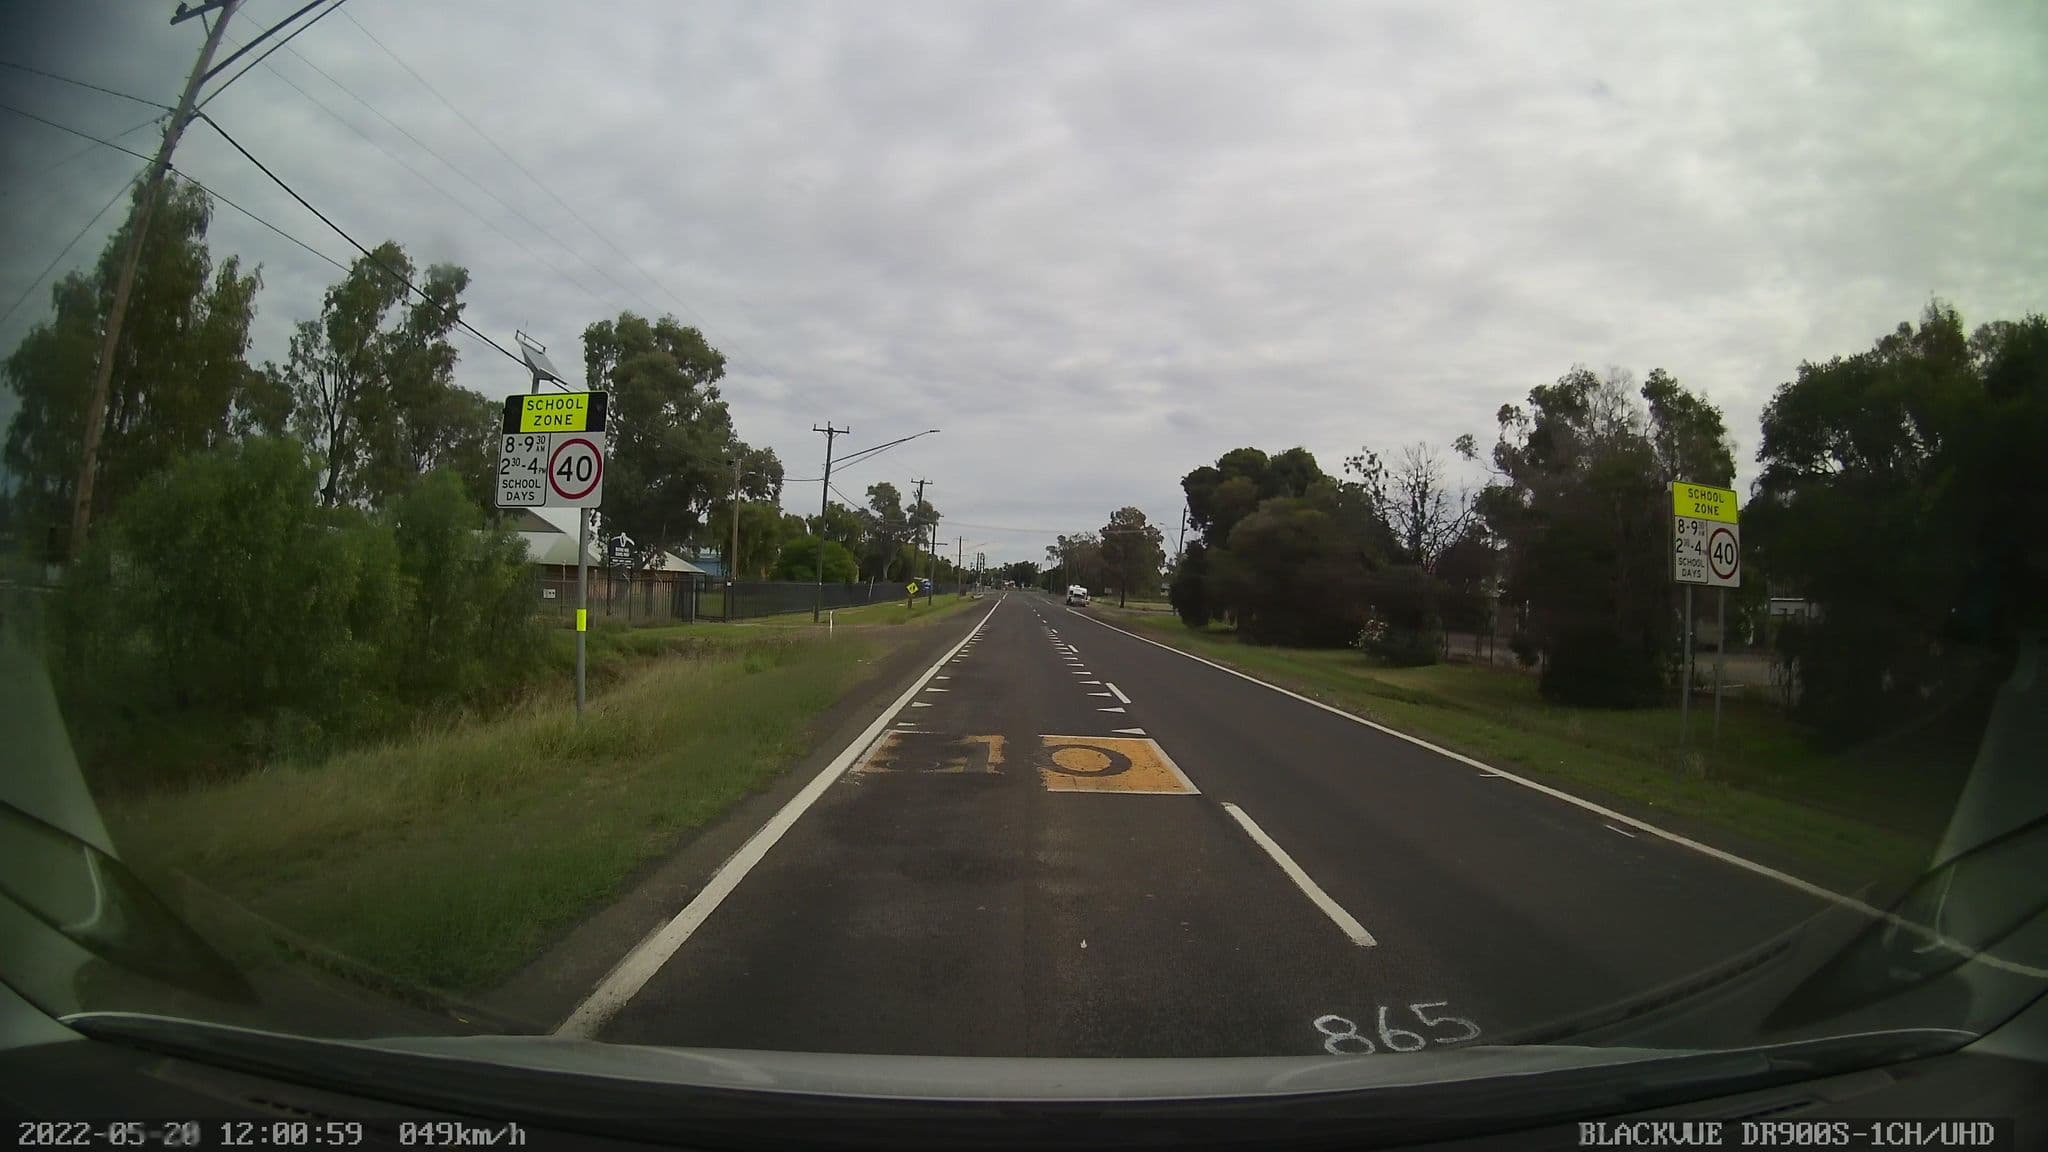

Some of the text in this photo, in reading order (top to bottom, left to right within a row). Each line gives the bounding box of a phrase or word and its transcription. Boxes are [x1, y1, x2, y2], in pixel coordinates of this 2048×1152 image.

[526, 398, 584, 411] SCHOOL
[533, 414, 574, 426] ZONE
[556, 455, 593, 482] 40
[502, 478, 541, 489] SCHOOL
[506, 491, 535, 501] DAYS
[1687, 488, 1724, 504] SCHOOL
[1694, 503, 1720, 516] ZONE
[1713, 542, 1734, 565] 40
[1678, 557, 1705, 568] SCHOOL
[1681, 568, 1702, 578] DAYS
[1313, 1001, 1482, 1056] 865
